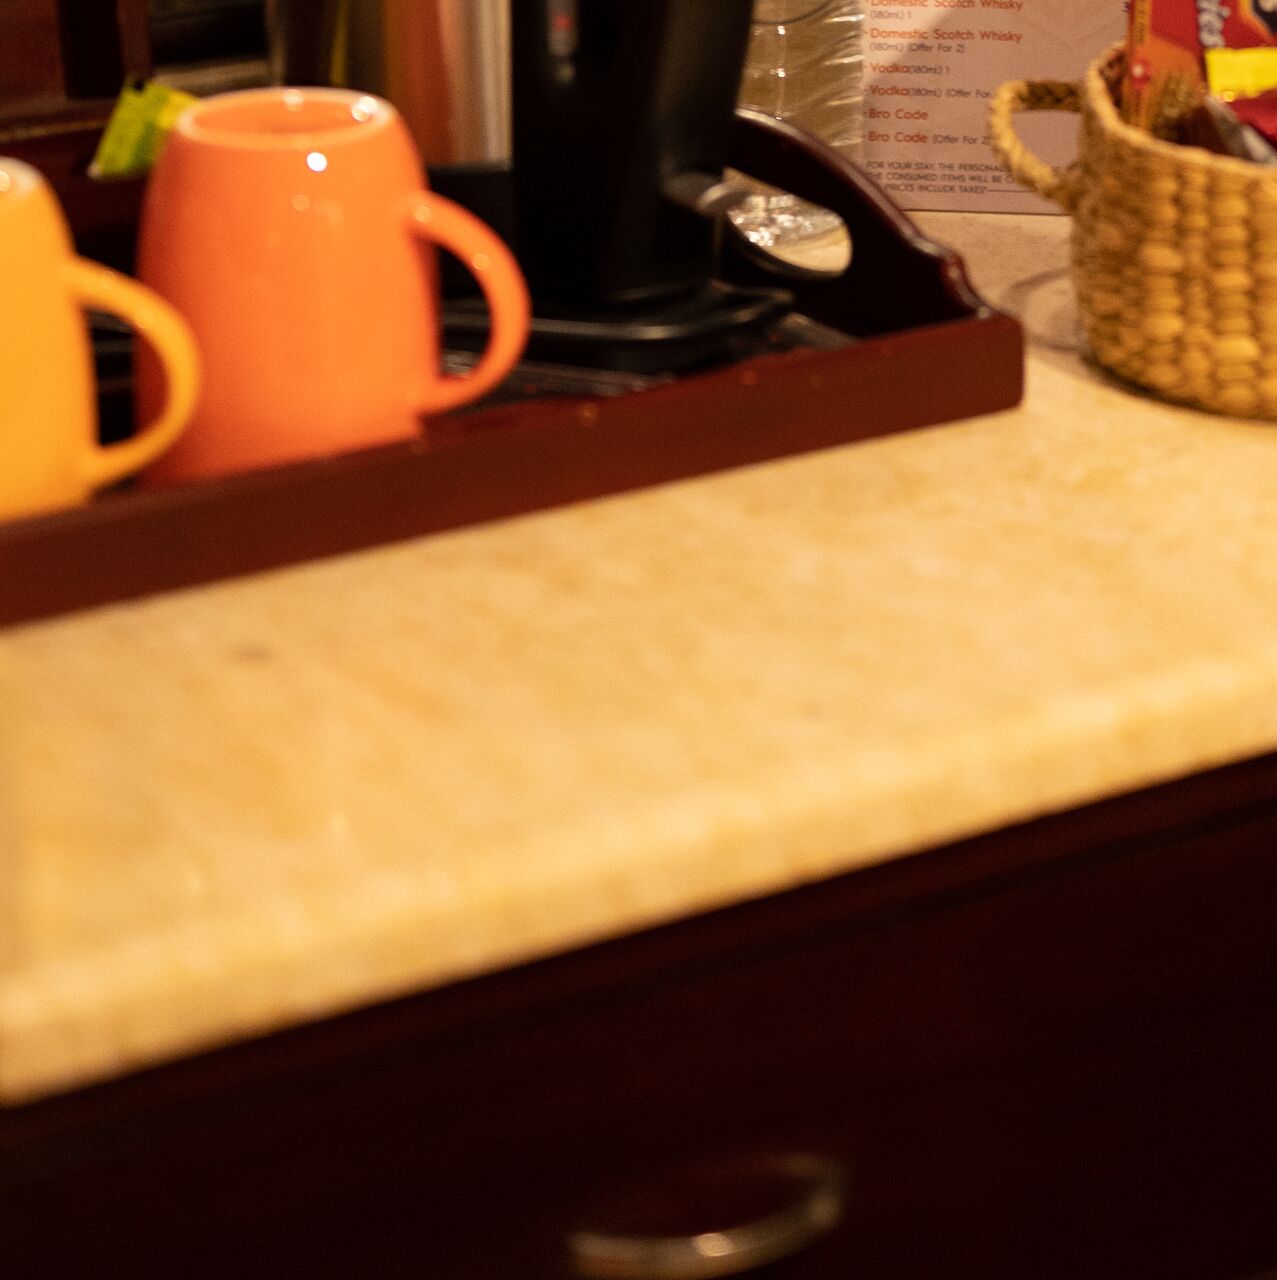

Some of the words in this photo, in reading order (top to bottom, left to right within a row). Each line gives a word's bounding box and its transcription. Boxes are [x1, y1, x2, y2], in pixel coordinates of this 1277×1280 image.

[870, 28, 929, 40] Domestic
[933, 28, 975, 40] Scotch
[979, 30, 1023, 44] Whisky
[868, 108, 891, 119] Bro
[894, 109, 929, 120] Code
[868, 130, 890, 142] Bro
[894, 131, 929, 143] Code
